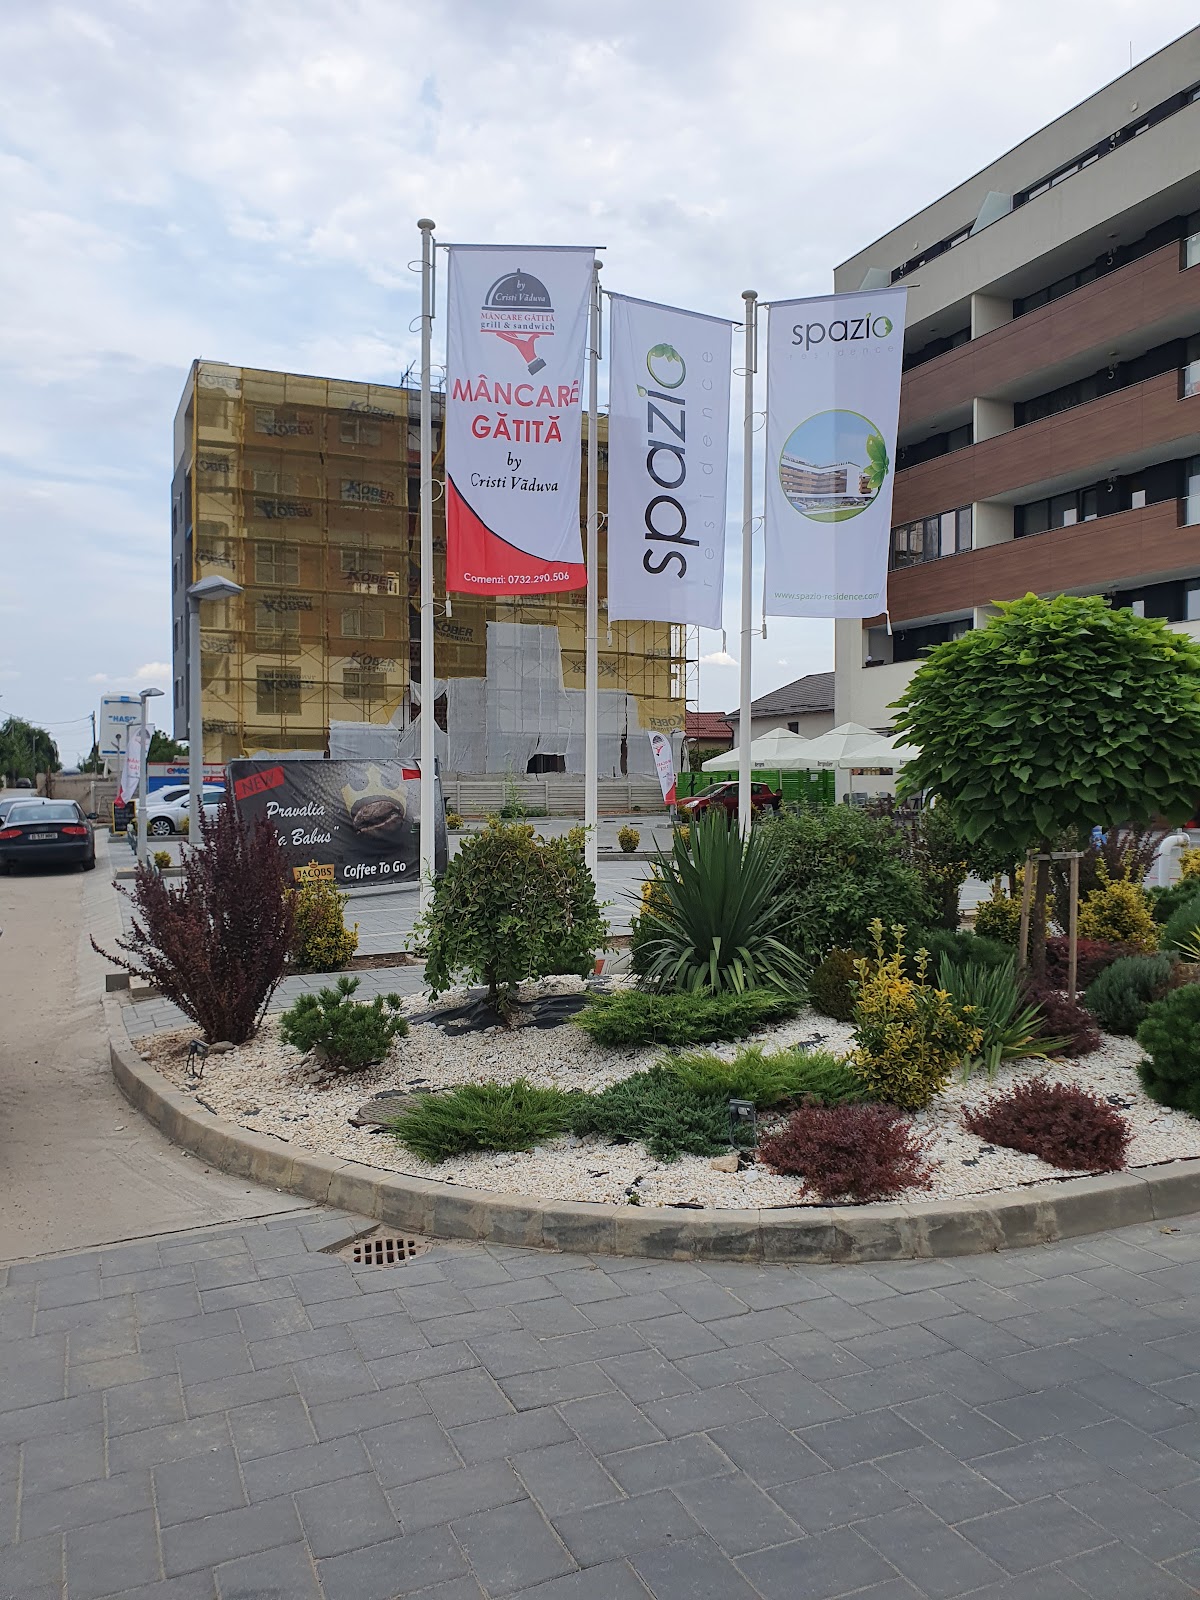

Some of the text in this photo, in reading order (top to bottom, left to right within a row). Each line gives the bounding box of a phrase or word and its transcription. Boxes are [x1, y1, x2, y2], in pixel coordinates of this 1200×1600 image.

[516, 280, 525, 291] by
[495, 292, 517, 302] Cristi
[480, 312, 522, 321] MÂNCARE
[480, 321, 501, 330] grill
[513, 322, 555, 331] sandwich
[791, 312, 893, 351] spazio
[471, 411, 562, 444] GĂTITĂ
[507, 452, 522, 472] by
[636, 342, 700, 579] spazio
[699, 351, 715, 588] residence
[471, 473, 506, 488] Cristi
[463, 571, 570, 584] Comenzi: 0732.290.506
[242, 772, 275, 795] NEW
[266, 801, 326, 820] Pravalia
[296, 866, 333, 879] JACOBS
[343, 860, 407, 880] Coffee To Go
